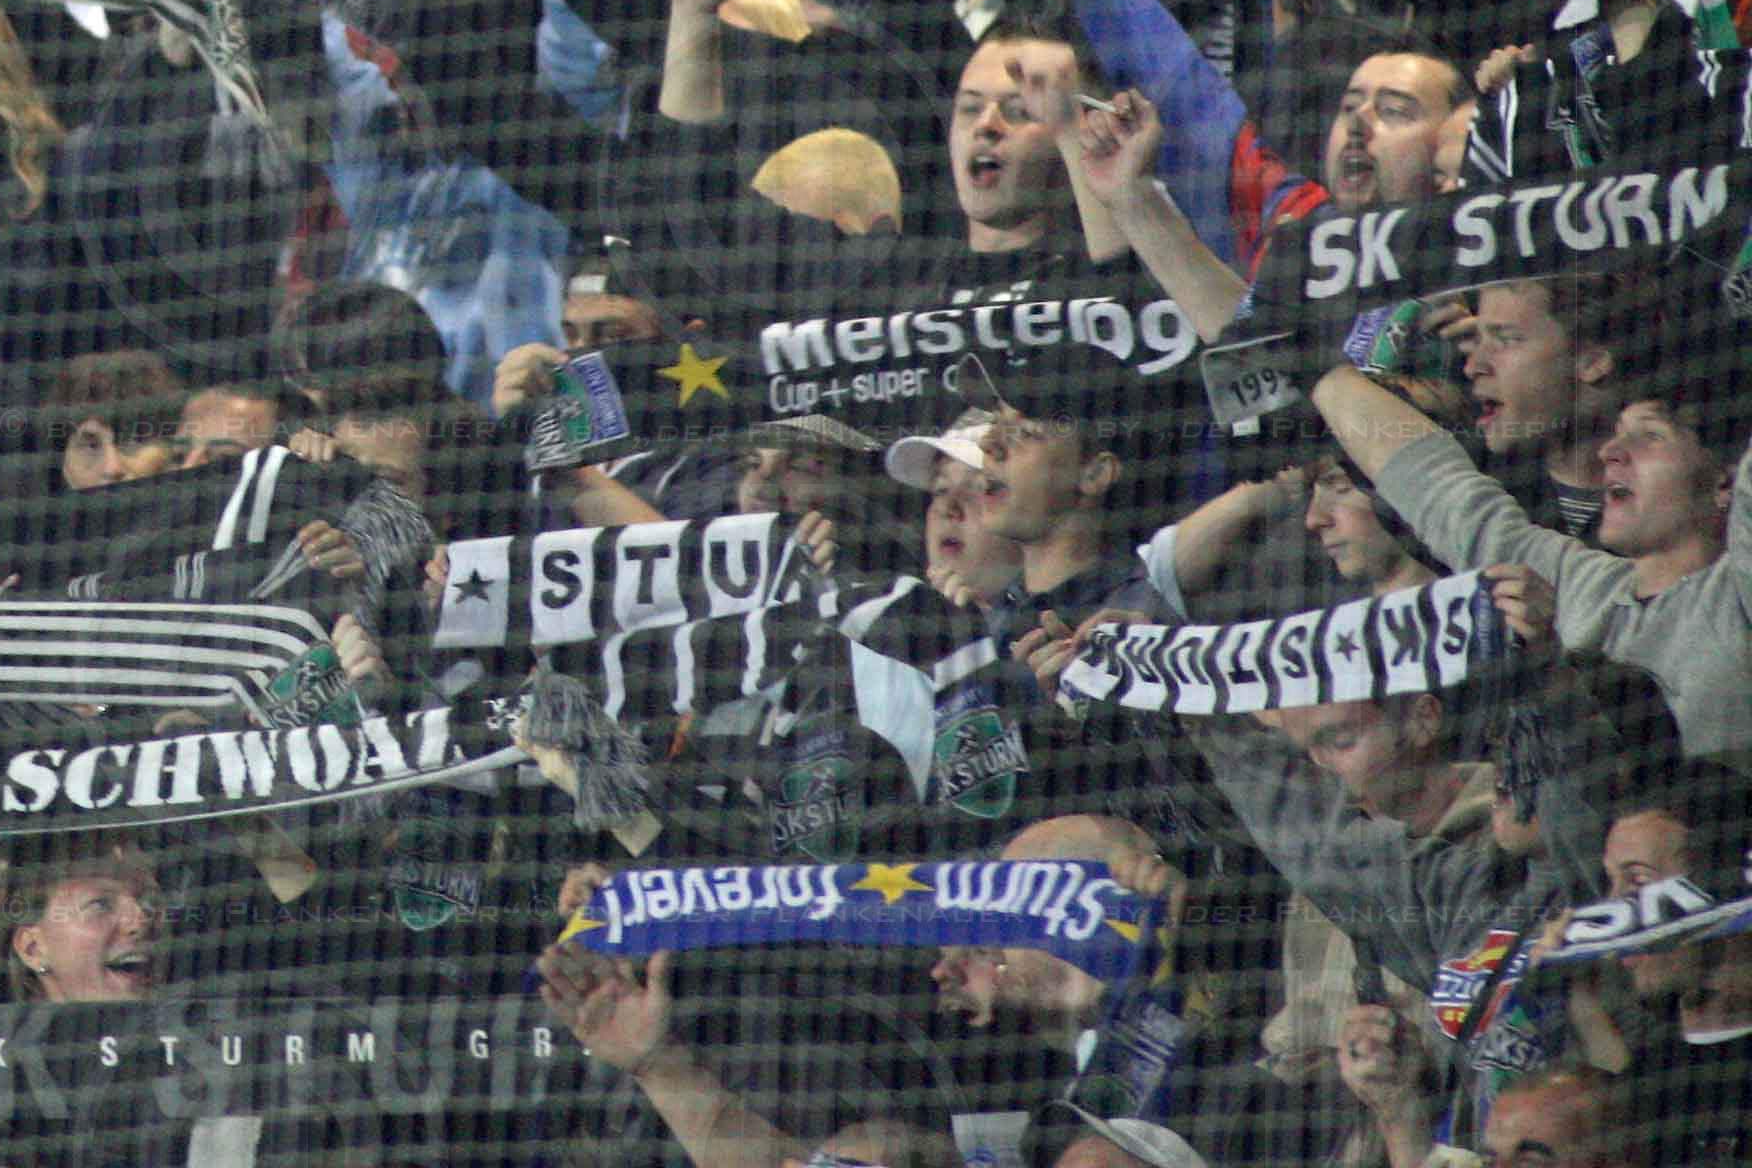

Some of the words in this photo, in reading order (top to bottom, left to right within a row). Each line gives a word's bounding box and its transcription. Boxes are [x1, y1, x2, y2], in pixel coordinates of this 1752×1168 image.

[1303, 207, 1411, 301] SK
[769, 373, 821, 416] Cup
[851, 366, 930, 405] super
[601, 863, 845, 945] forever!
[934, 860, 1132, 942] Sturm
